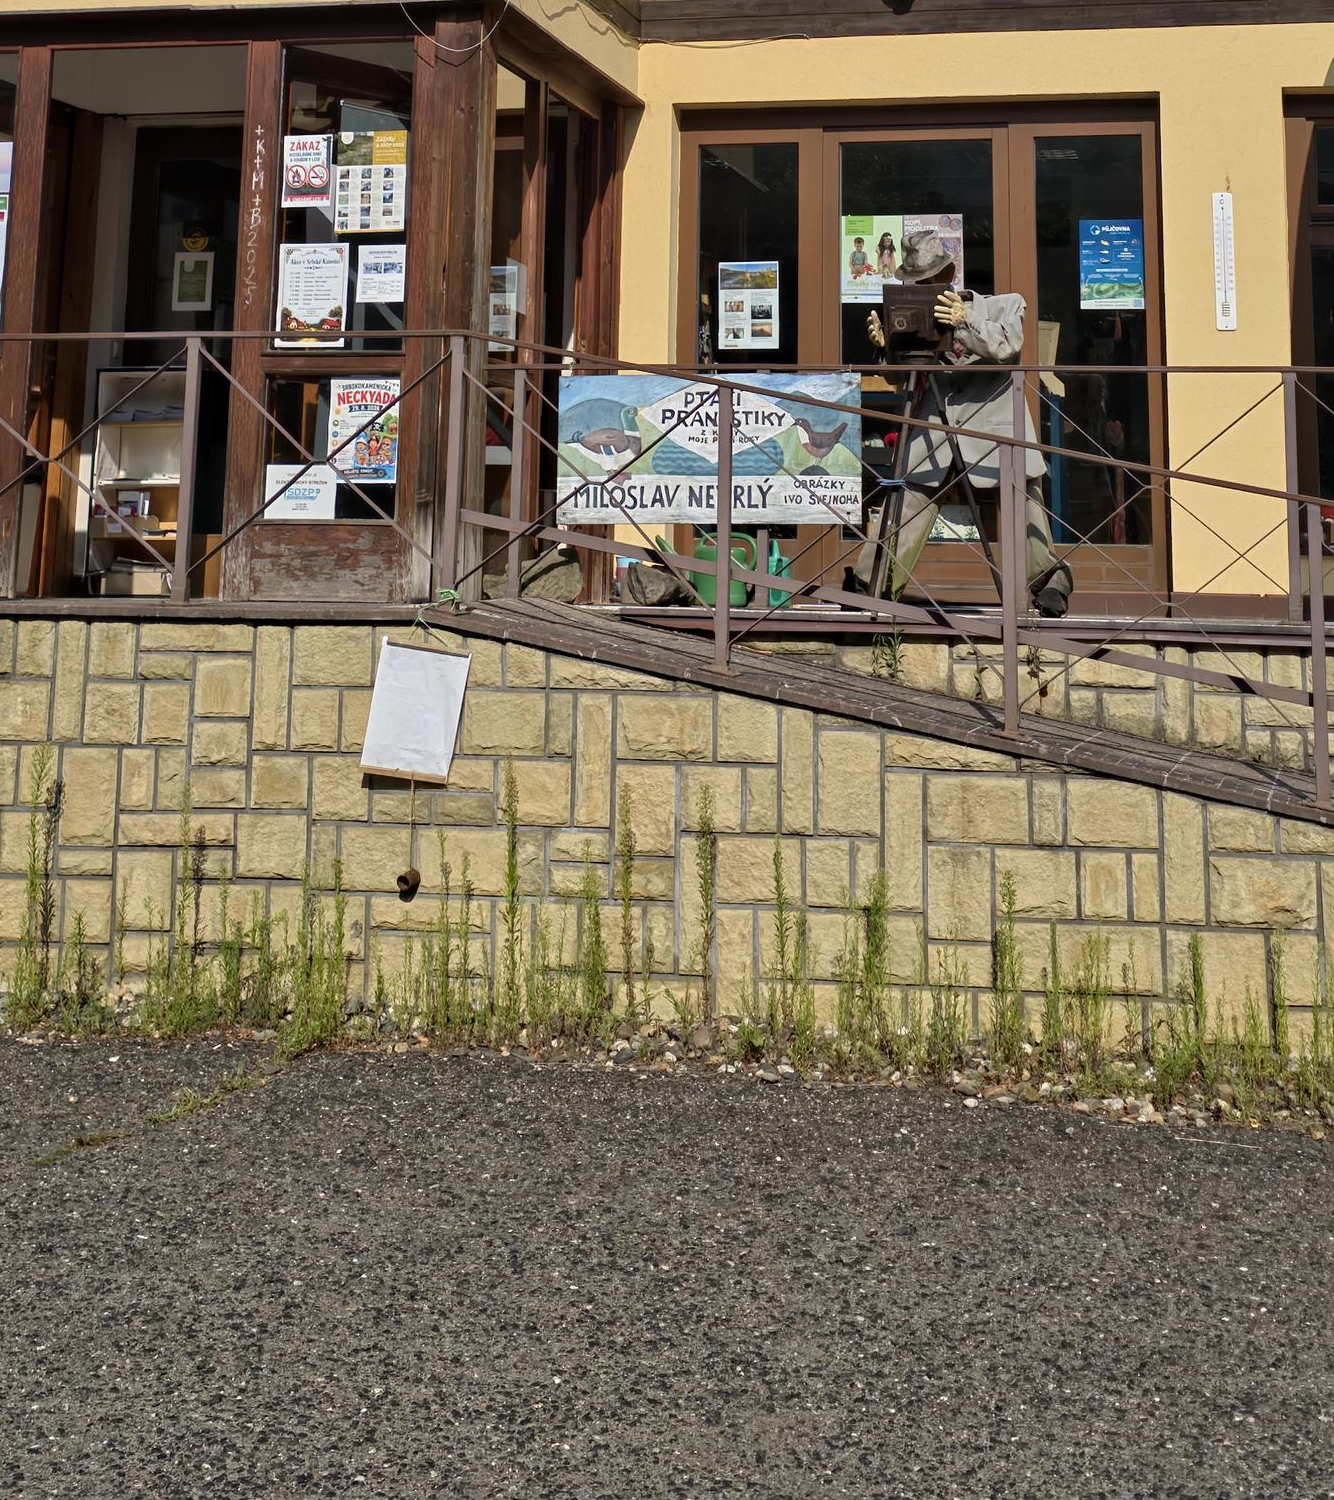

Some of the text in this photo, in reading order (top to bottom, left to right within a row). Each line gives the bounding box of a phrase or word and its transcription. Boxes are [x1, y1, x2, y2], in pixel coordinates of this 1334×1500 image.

[289, 139, 321, 152] ZÁKAZ
[661, 408, 786, 428] PRANSTIKY
[688, 435, 708, 444] MOJE
[793, 476, 846, 490] OBRÁZKY
[287, 488, 315, 496] SDZP
[573, 477, 774, 510] MILOSLAV NERLÝ
[784, 494, 803, 505] IVO
